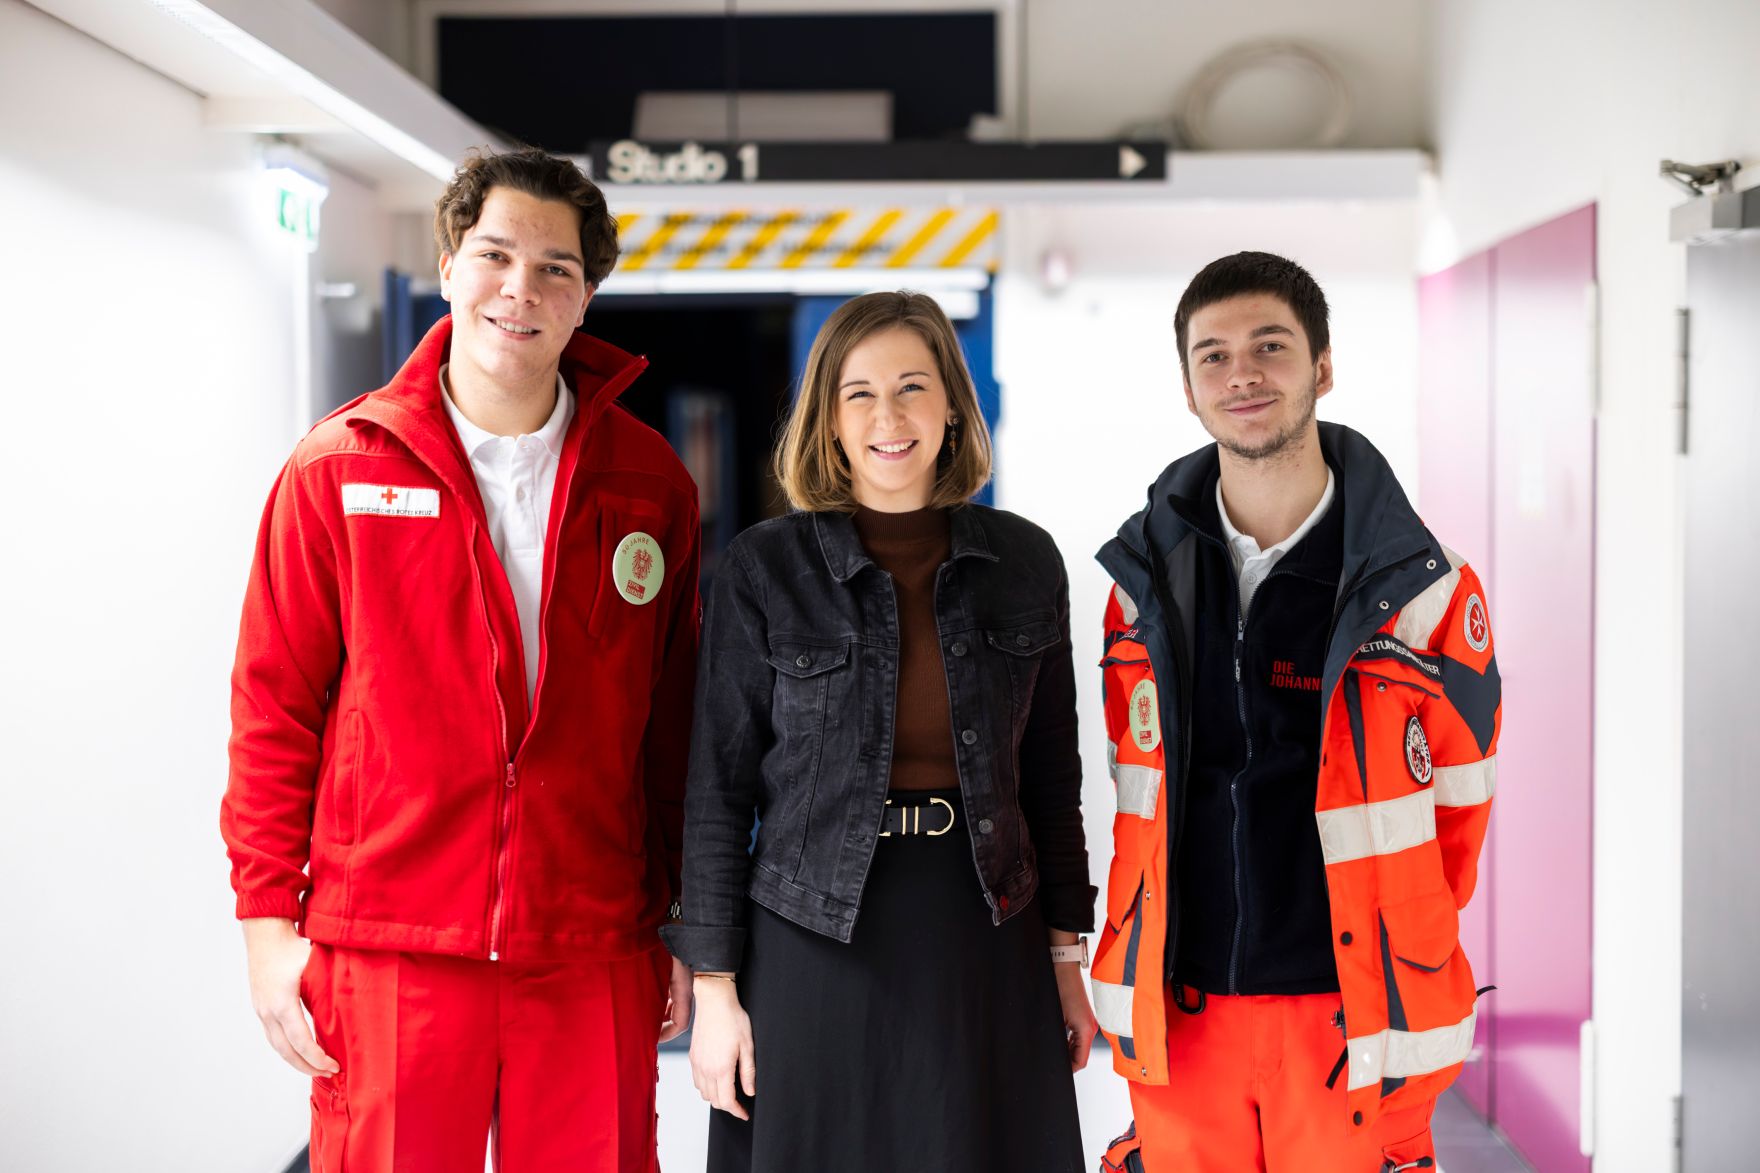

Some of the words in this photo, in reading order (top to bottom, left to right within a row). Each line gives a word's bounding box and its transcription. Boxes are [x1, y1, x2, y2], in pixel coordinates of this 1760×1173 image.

[608, 140, 728, 184] Studio
[737, 143, 759, 183] 1
[630, 537, 649, 547] JAHRE
[1273, 660, 1295, 675] DIE
[1270, 673, 1321, 691] JOHANN
